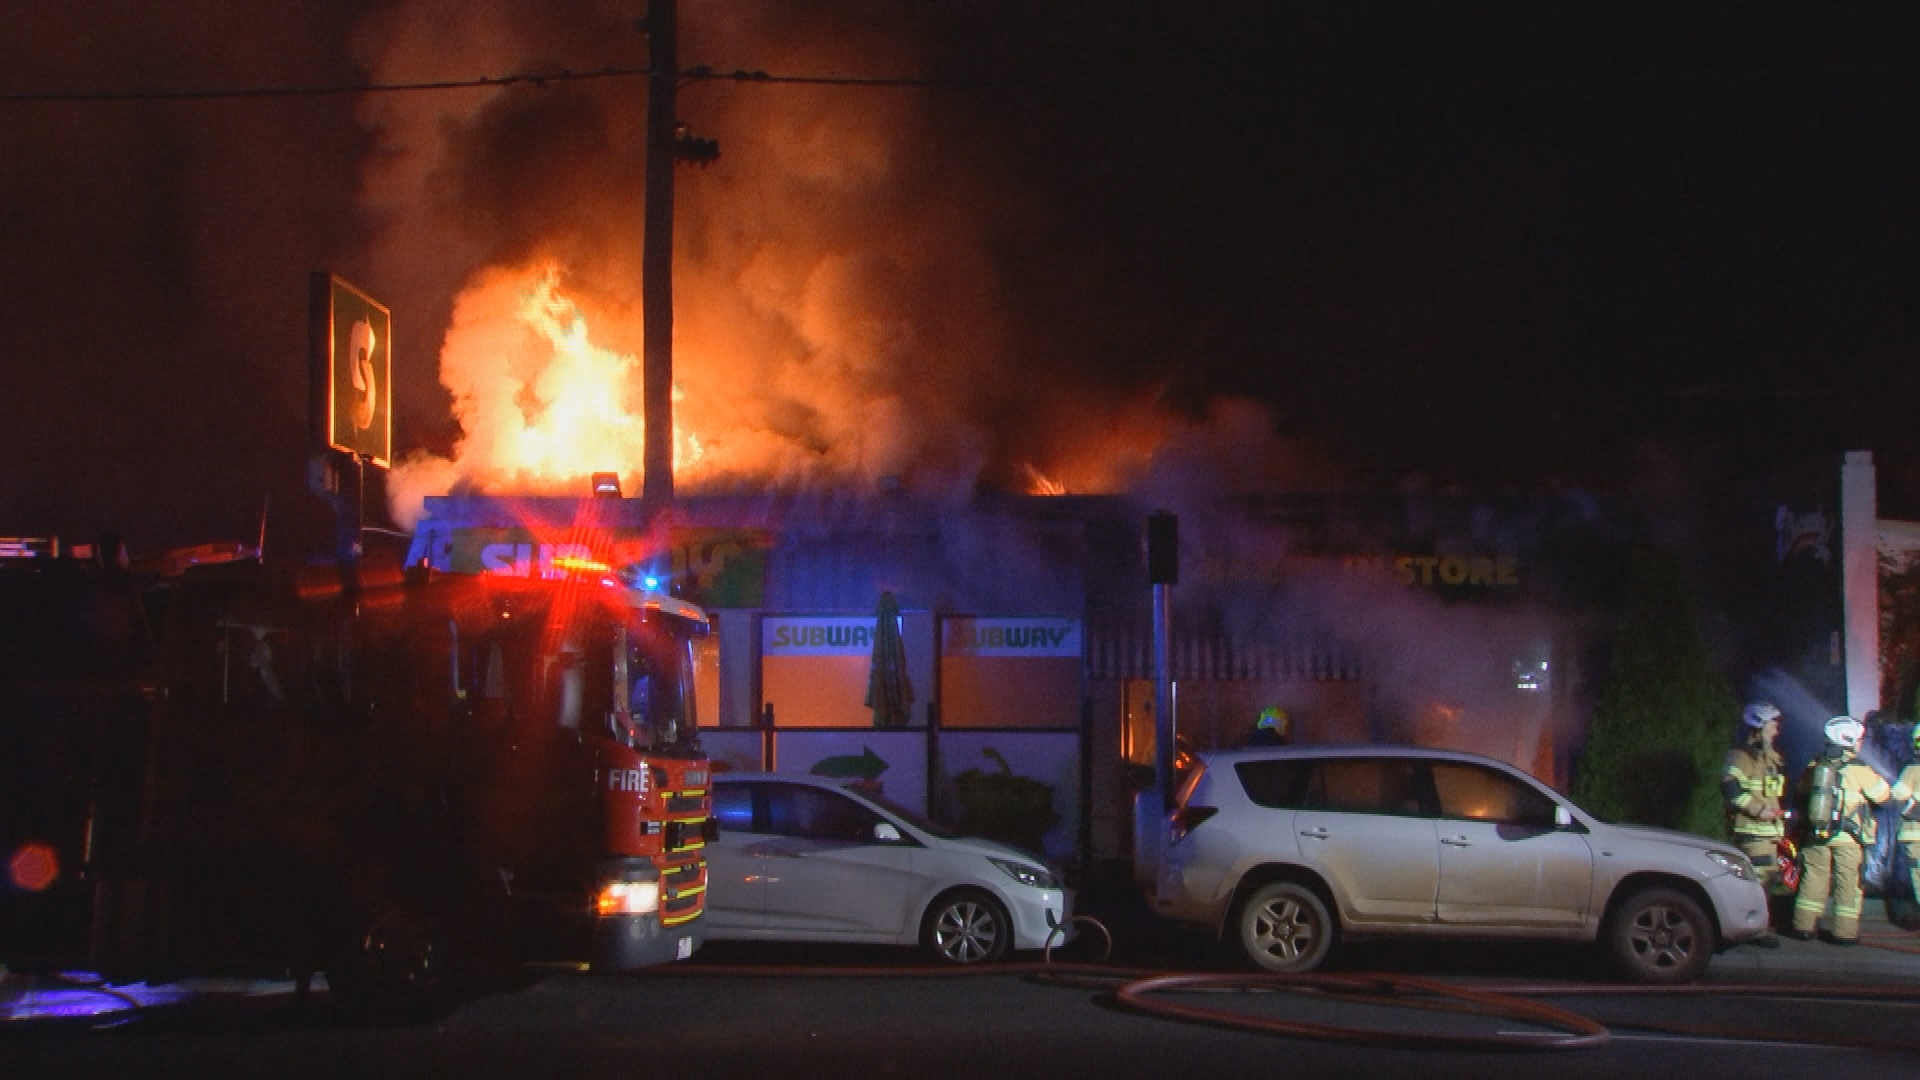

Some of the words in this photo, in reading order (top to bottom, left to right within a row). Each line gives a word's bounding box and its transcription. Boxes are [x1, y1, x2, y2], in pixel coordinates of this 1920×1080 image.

[350, 314, 376, 435] S
[1394, 557, 1519, 585] STORE
[772, 626, 877, 646] SUBWA
[609, 769, 649, 792] FIRE
